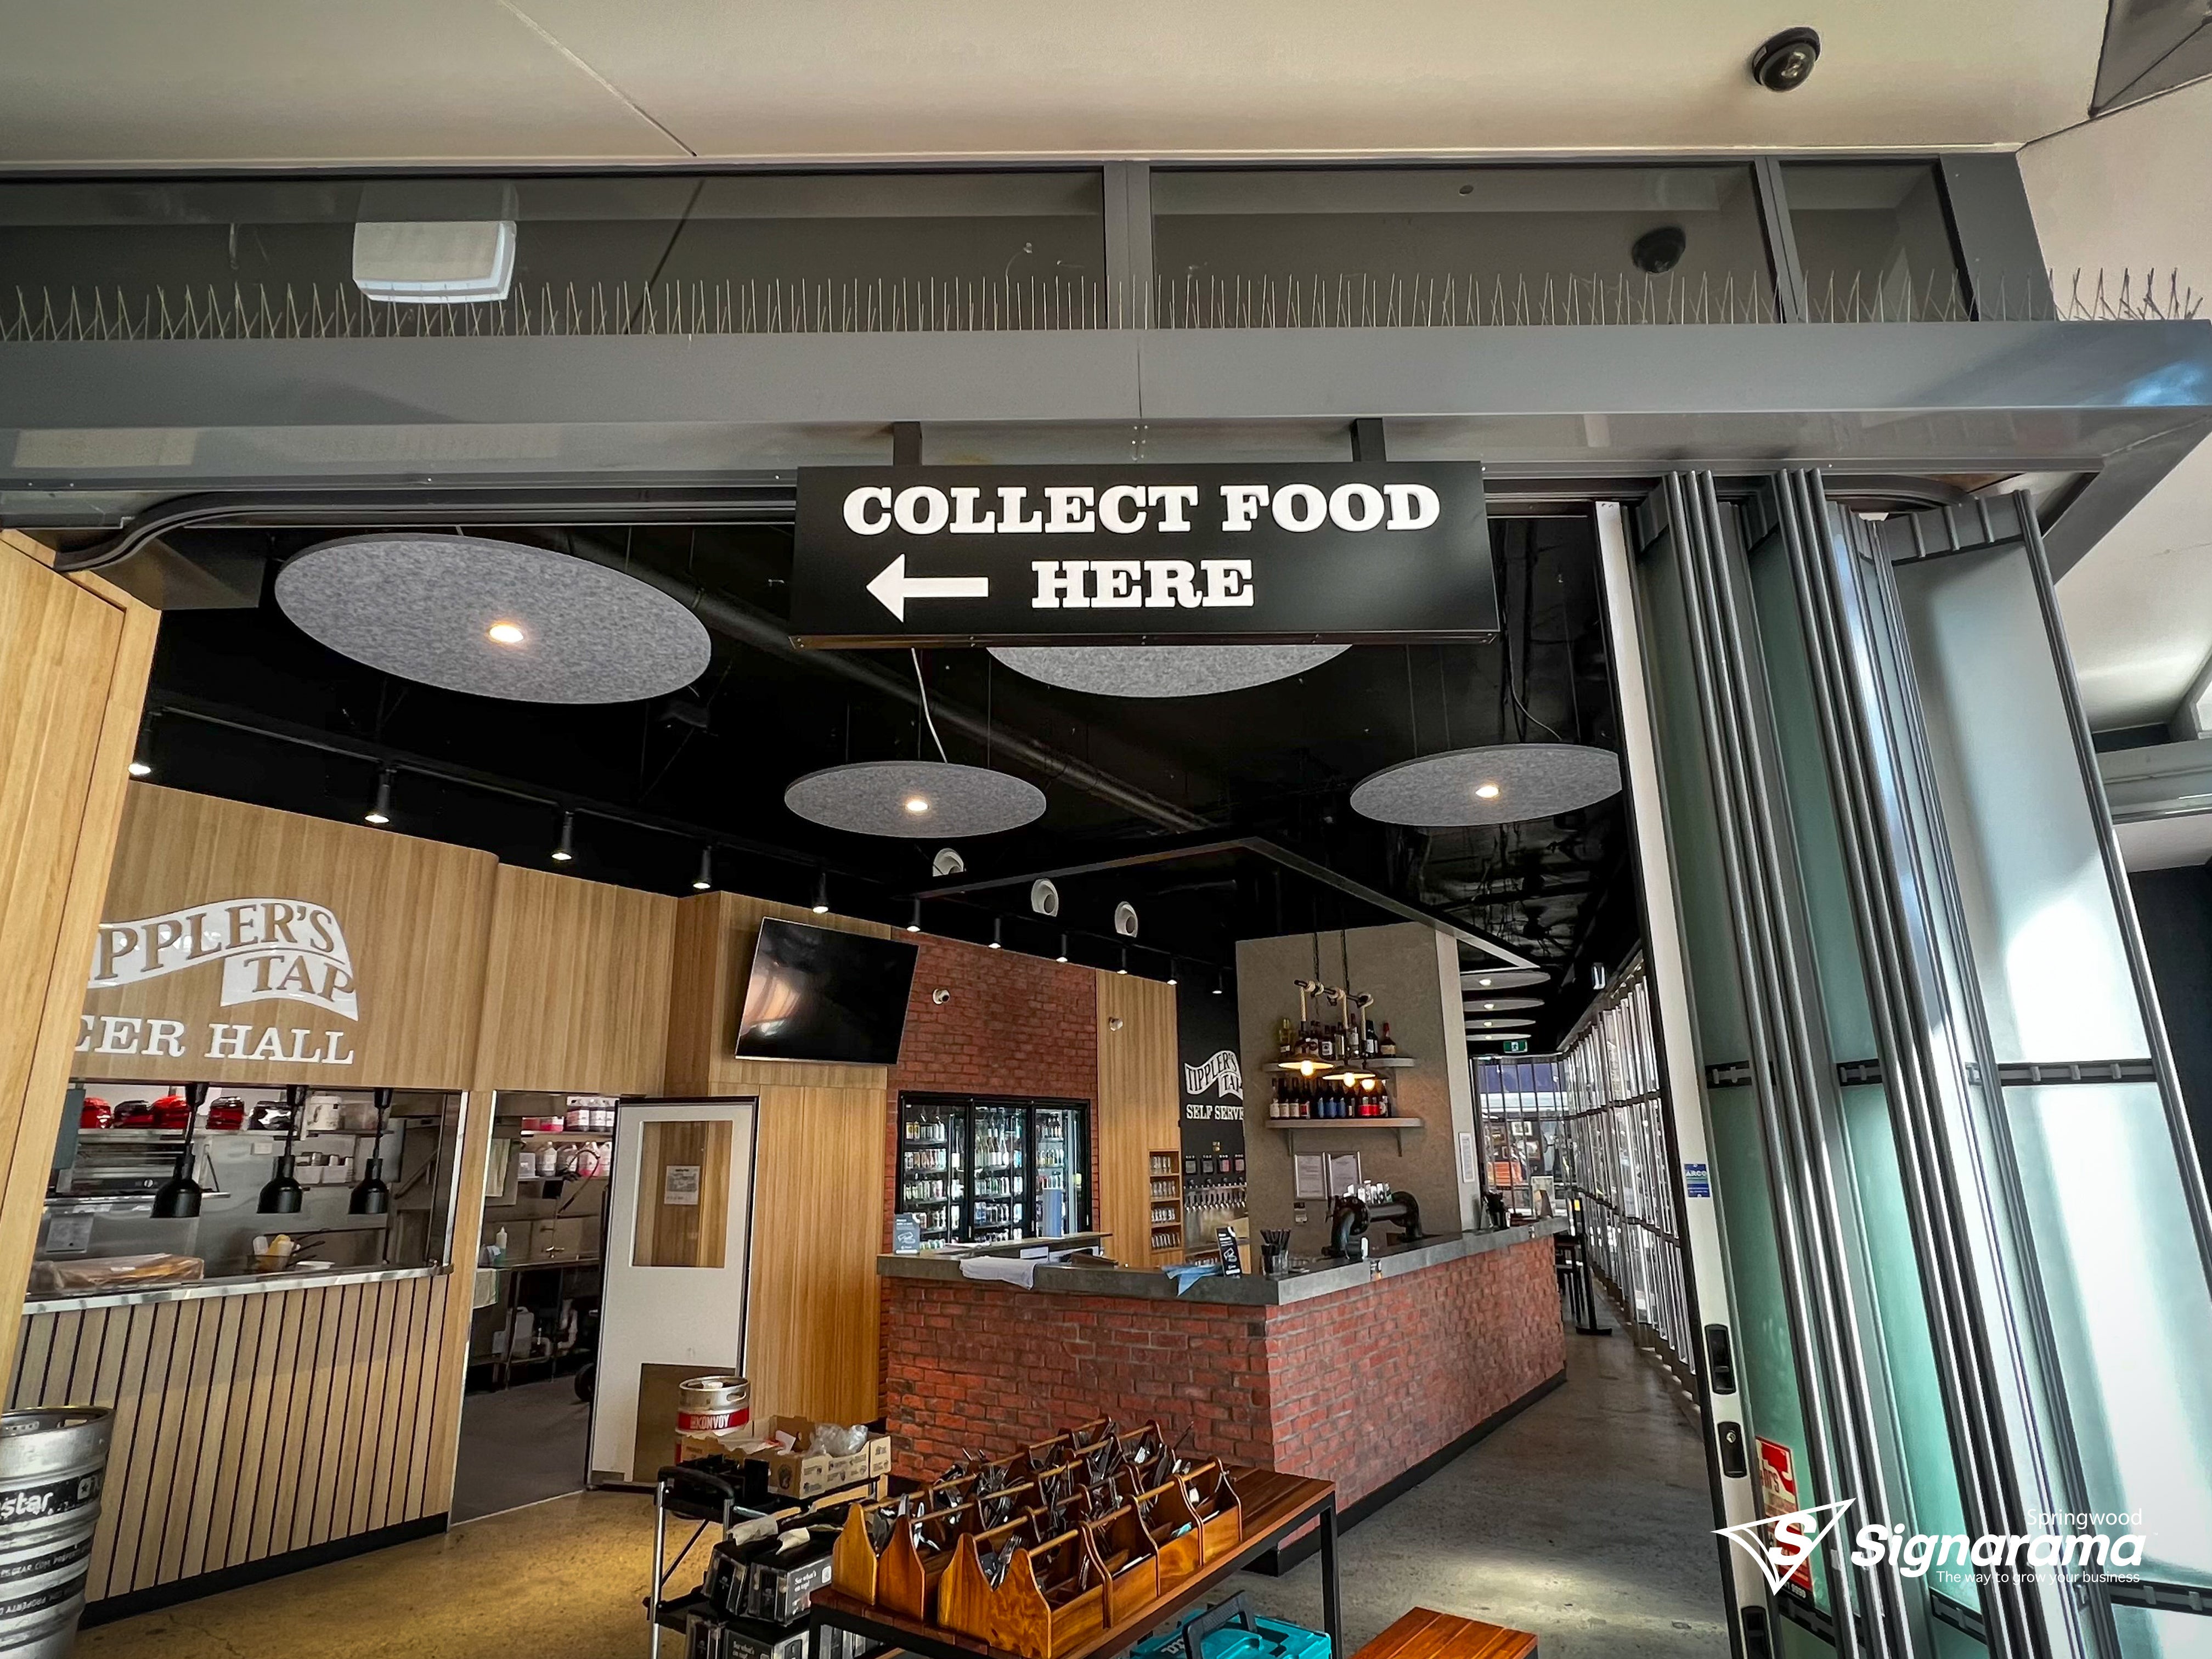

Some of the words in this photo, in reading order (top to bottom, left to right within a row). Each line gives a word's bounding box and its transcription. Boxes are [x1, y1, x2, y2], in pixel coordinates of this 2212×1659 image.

[843, 485, 1199, 535] COLLECT
[1219, 483, 1441, 532] FOOD
[1030, 558, 1254, 608] HERE
[89, 902, 334, 980] PPLER'S
[243, 954, 354, 1002] TAP
[74, 1014, 185, 1058] ER
[204, 1023, 354, 1065] HALL
[1186, 1052, 1237, 1091] TIPPLER'S
[1186, 1104, 1213, 1119] SELF
[696, 1413, 730, 1430] KONVOY
[0, 1491, 54, 1519] star
